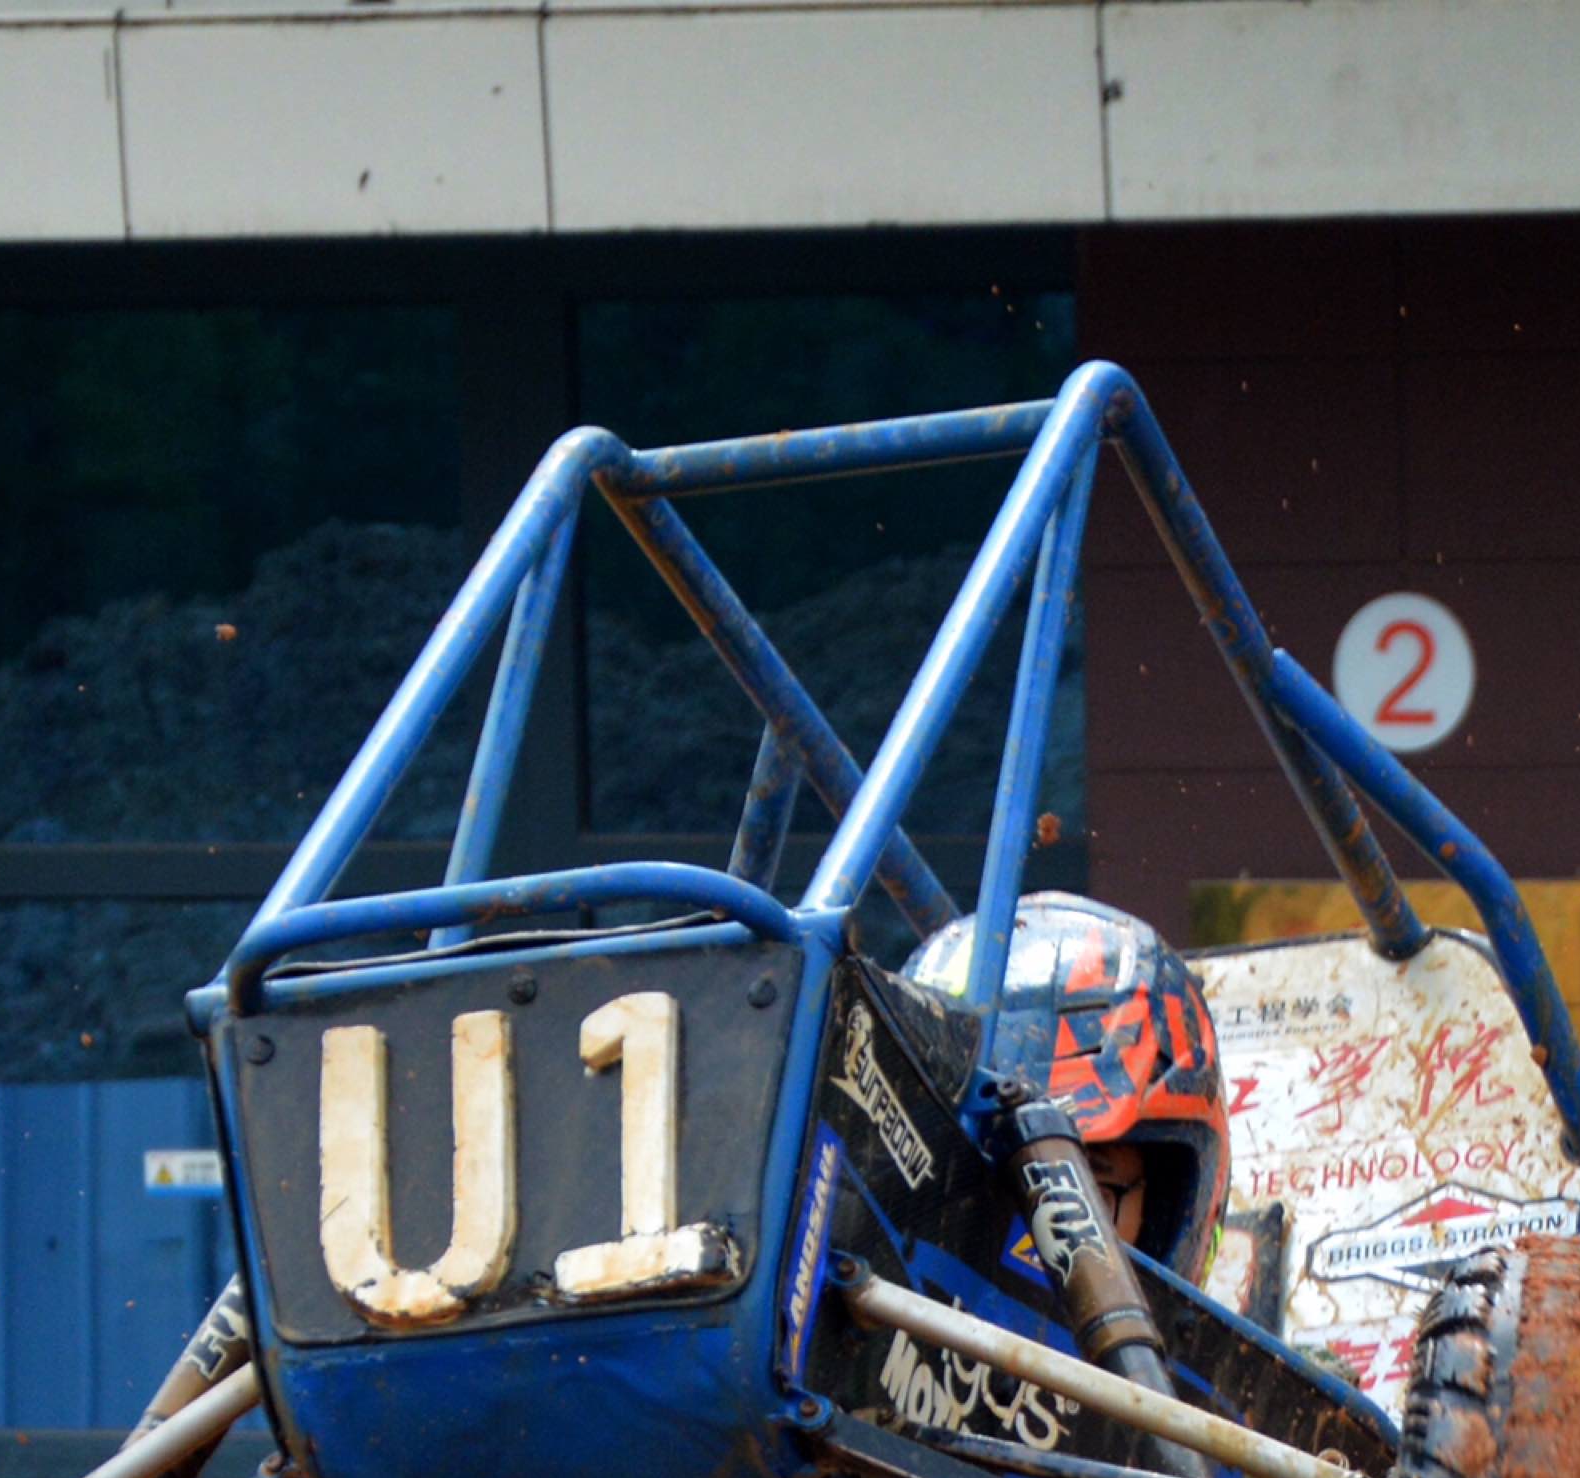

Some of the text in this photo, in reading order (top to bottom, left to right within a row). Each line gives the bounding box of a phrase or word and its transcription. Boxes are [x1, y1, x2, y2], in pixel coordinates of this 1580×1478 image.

[1375, 620, 1437, 726] 2
[319, 991, 741, 1327] U1
[1250, 1142, 1517, 1198] TECHNOLOGY
[1023, 1158, 1111, 1288] FOX
